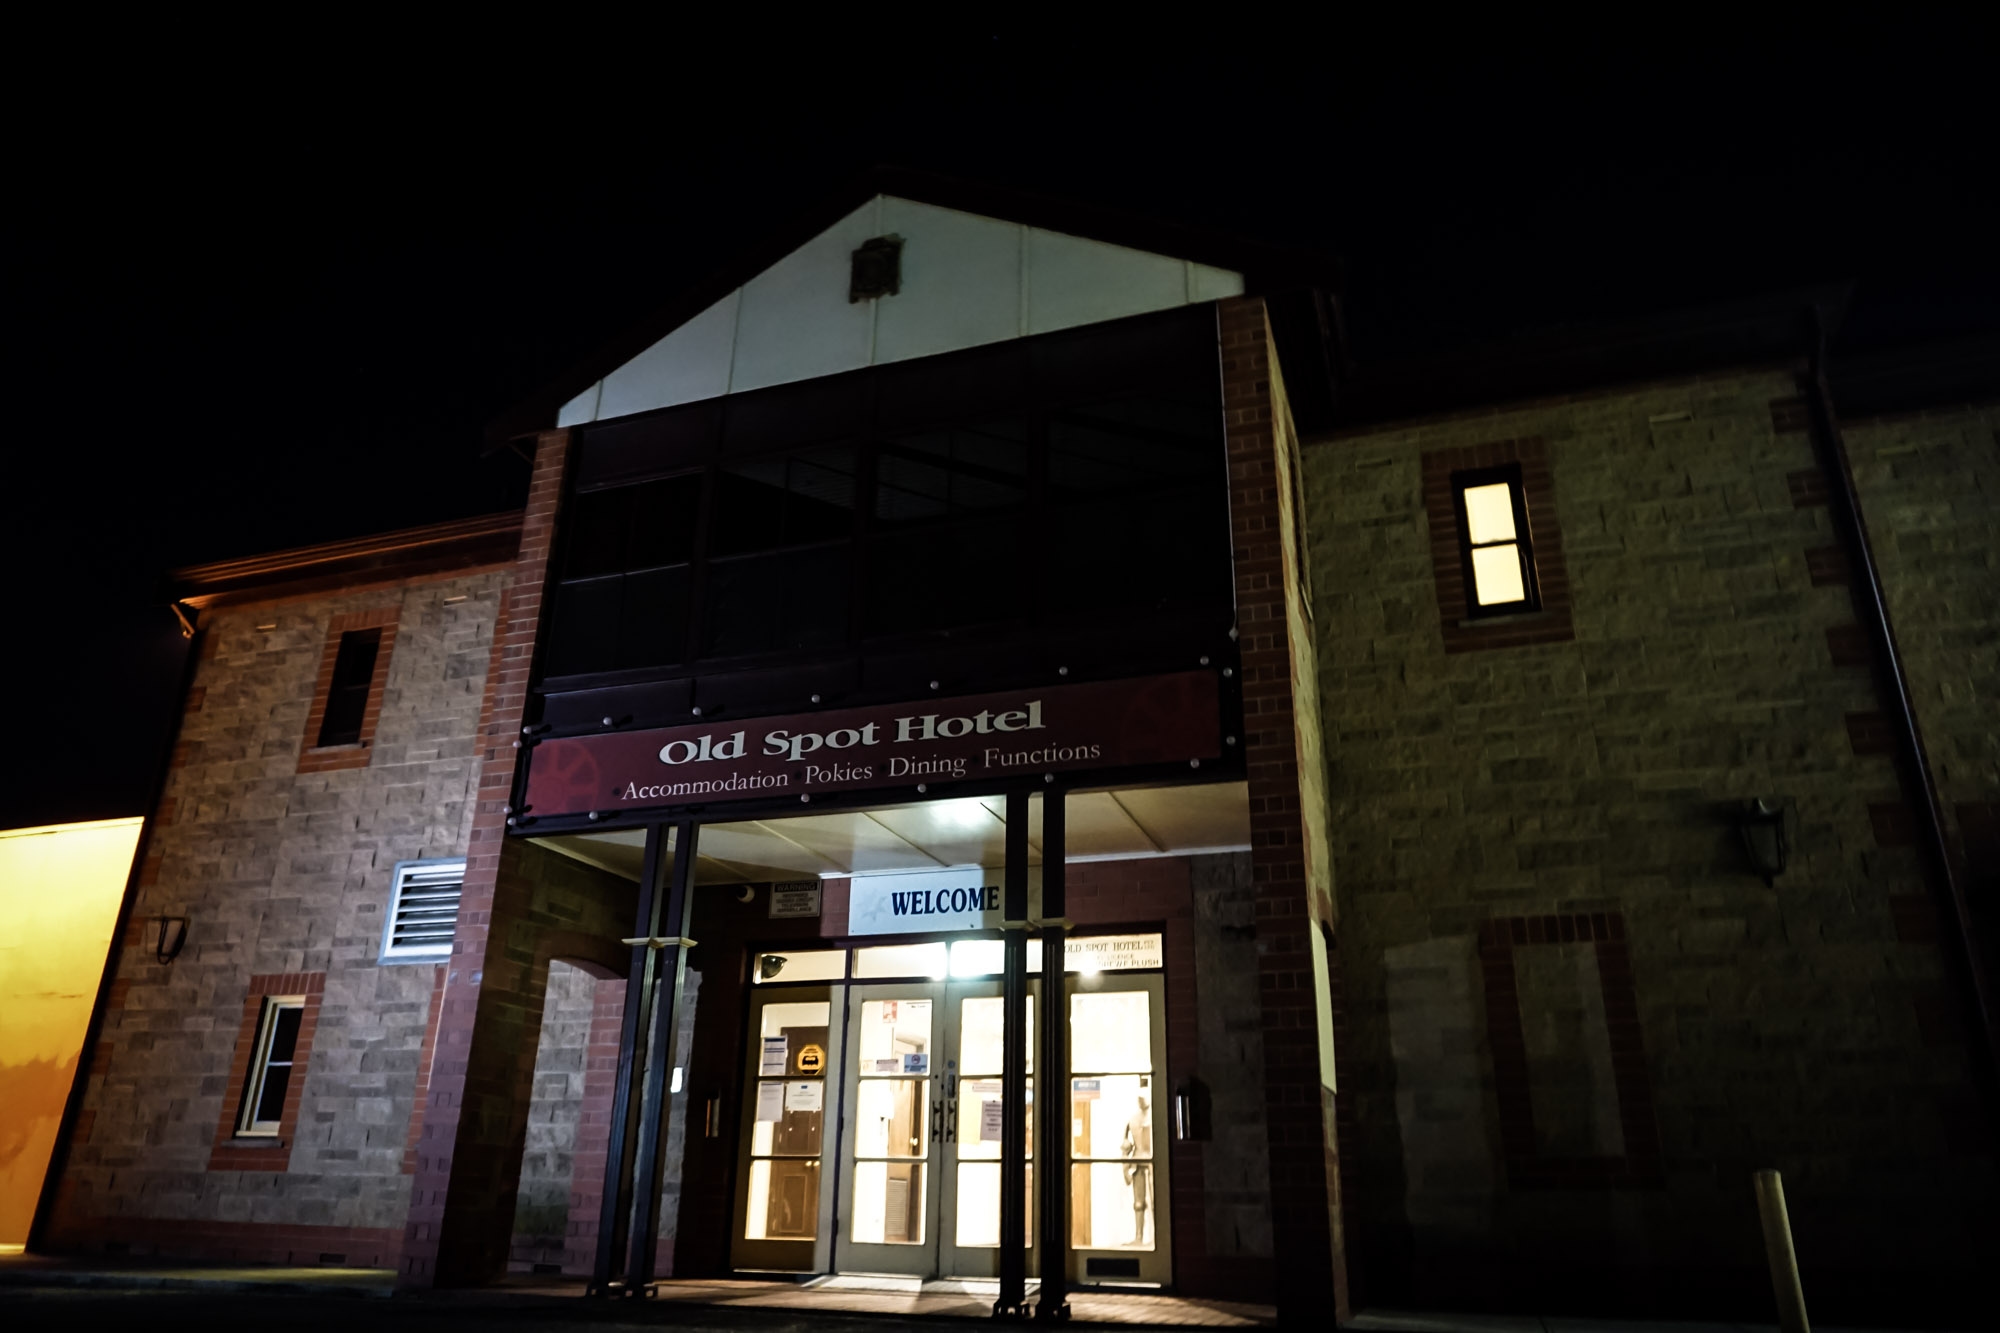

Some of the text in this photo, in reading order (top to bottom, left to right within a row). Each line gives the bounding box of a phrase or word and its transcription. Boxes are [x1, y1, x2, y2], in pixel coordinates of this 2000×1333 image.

[659, 700, 1047, 766] Old Spot Hotel
[621, 742, 1101, 800] Accommodation Pokies Dining Functions
[892, 886, 1000, 915] WELCOME
[1086, 942, 1109, 952] SPOT
[1113, 940, 1143, 952] HOTEL
